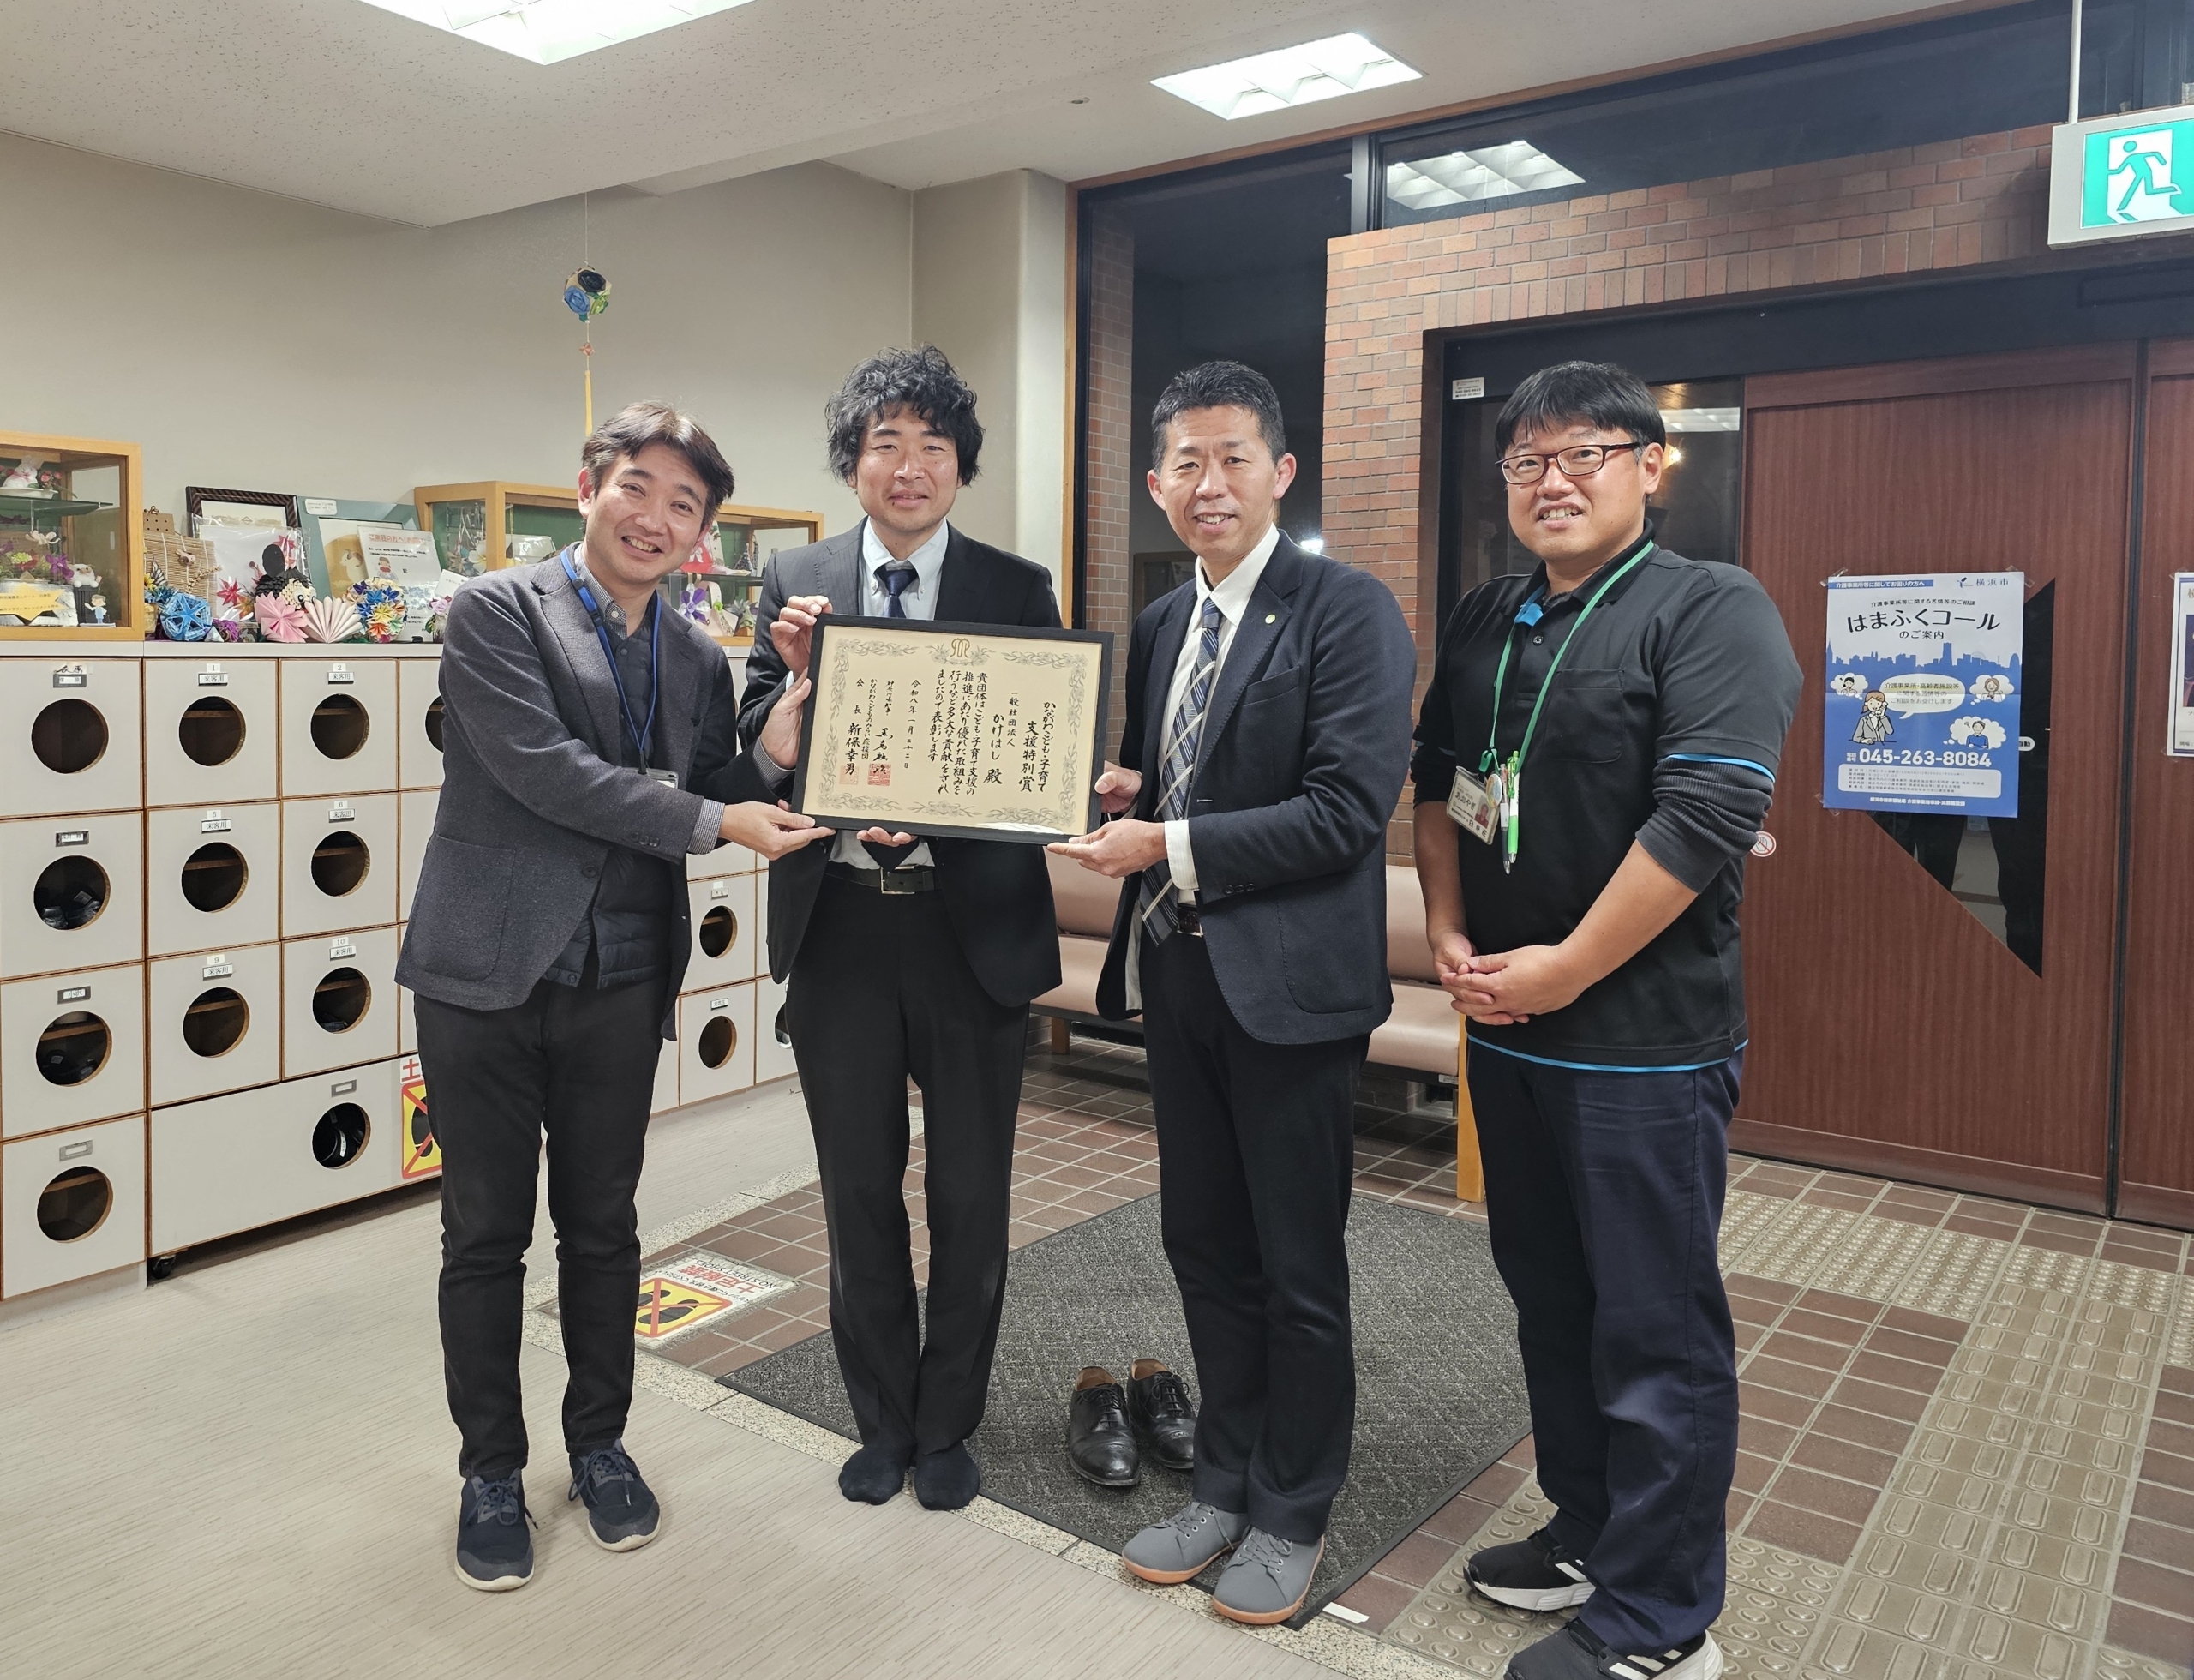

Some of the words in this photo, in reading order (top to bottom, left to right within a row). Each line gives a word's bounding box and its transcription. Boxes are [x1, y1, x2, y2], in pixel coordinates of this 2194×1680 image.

[1975, 578, 2010, 587] 横浜市
[1847, 608, 2001, 633] はまふくコール
[1899, 630, 1945, 639] のご案内
[902, 679, 921, 769] 令和八年一月二十二日
[928, 669, 946, 763] ましたので表彰します
[938, 670, 962, 795] 行うなど多大な貢献をされ
[953, 671, 975, 795] 推進にあたり優れた取組みを
[966, 672, 988, 796] 貴団体はこども・子育て支援の
[1006, 691, 1020, 747] 一般社団法人
[845, 723, 862, 776] 新保幸男
[990, 713, 1004, 760] かけはし
[1037, 701, 1057, 793] かながわこども・子育て
[1018, 720, 1040, 793] 支援特別賞
[1859, 748, 1992, 768] 045-263-8084
[982, 768, 1003, 785] 殿
[401, 1058, 421, 1083] 土
[677, 1264, 765, 1294] 土足厳禁
[695, 1259, 728, 1273] SHOES
[727, 1269, 758, 1283] STREET
[759, 1281, 777, 1289] NO
